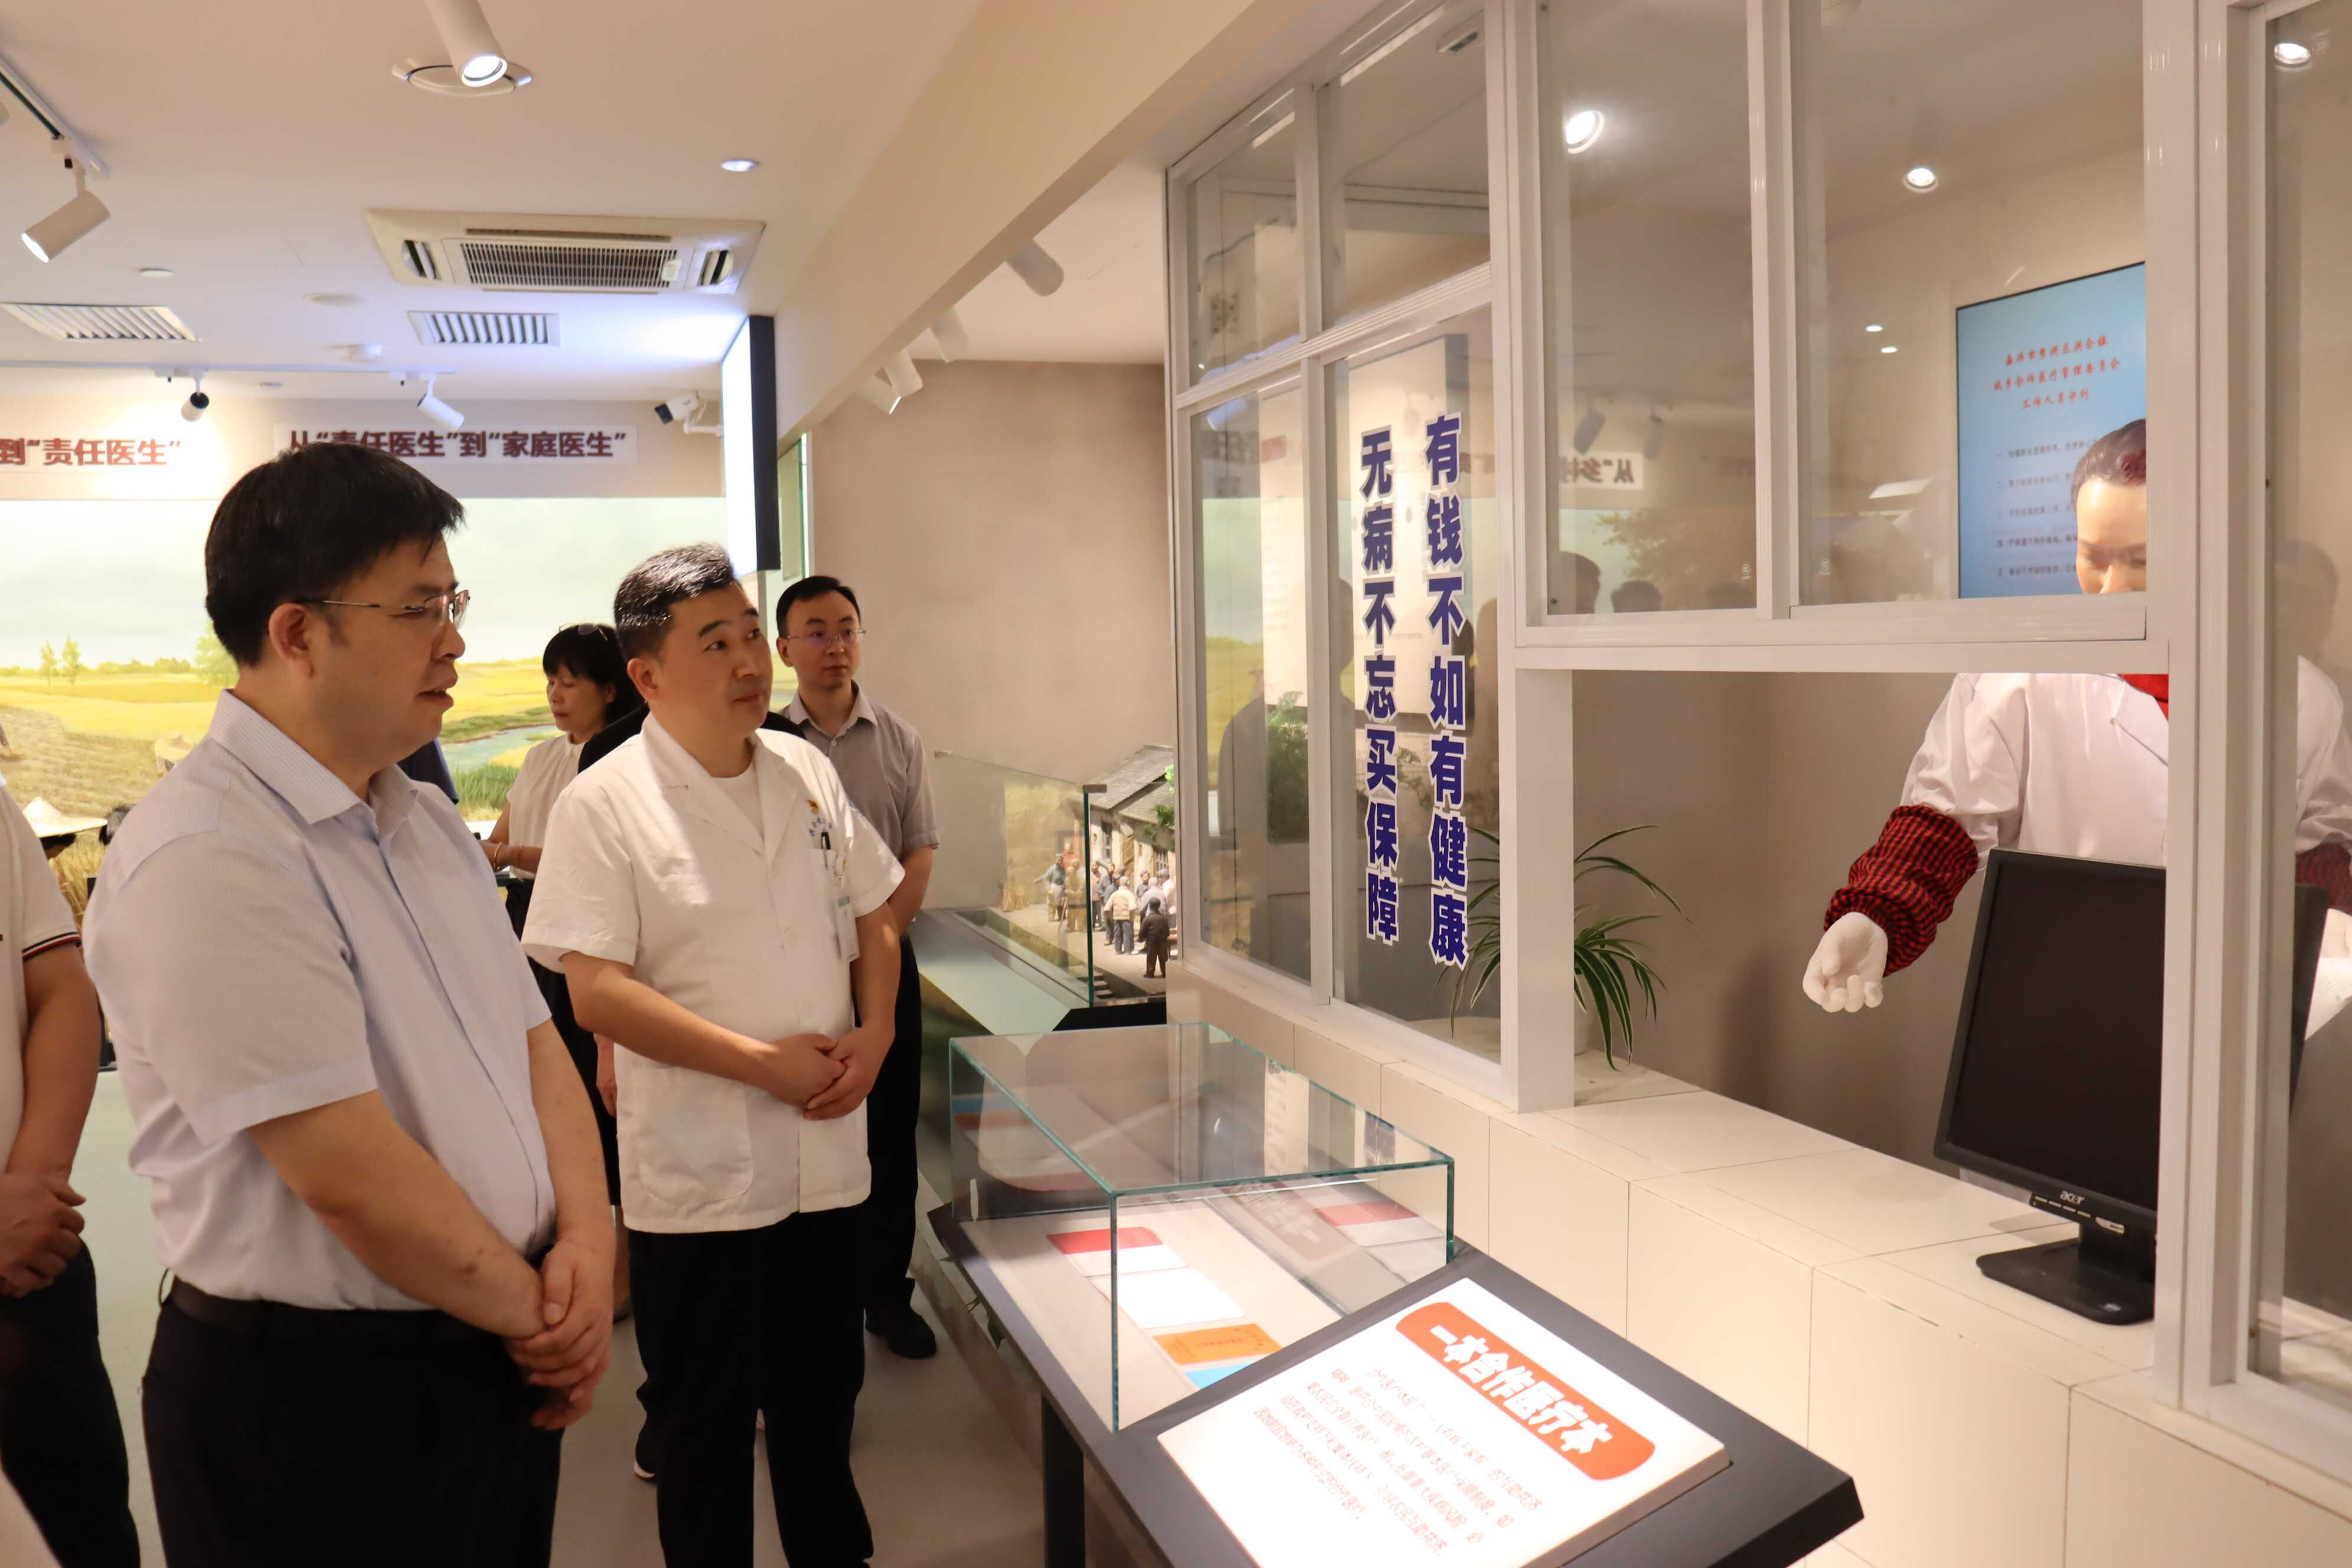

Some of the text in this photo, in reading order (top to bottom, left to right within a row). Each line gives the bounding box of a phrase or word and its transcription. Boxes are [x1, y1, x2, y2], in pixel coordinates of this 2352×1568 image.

[1360, 427, 1398, 943] 无病不忘买保障
[1426, 414, 1468, 967] 有钱不如有健康
[2060, 1190, 2085, 1205] acer
[1429, 1325, 1613, 1454] 一本合作医疗本
